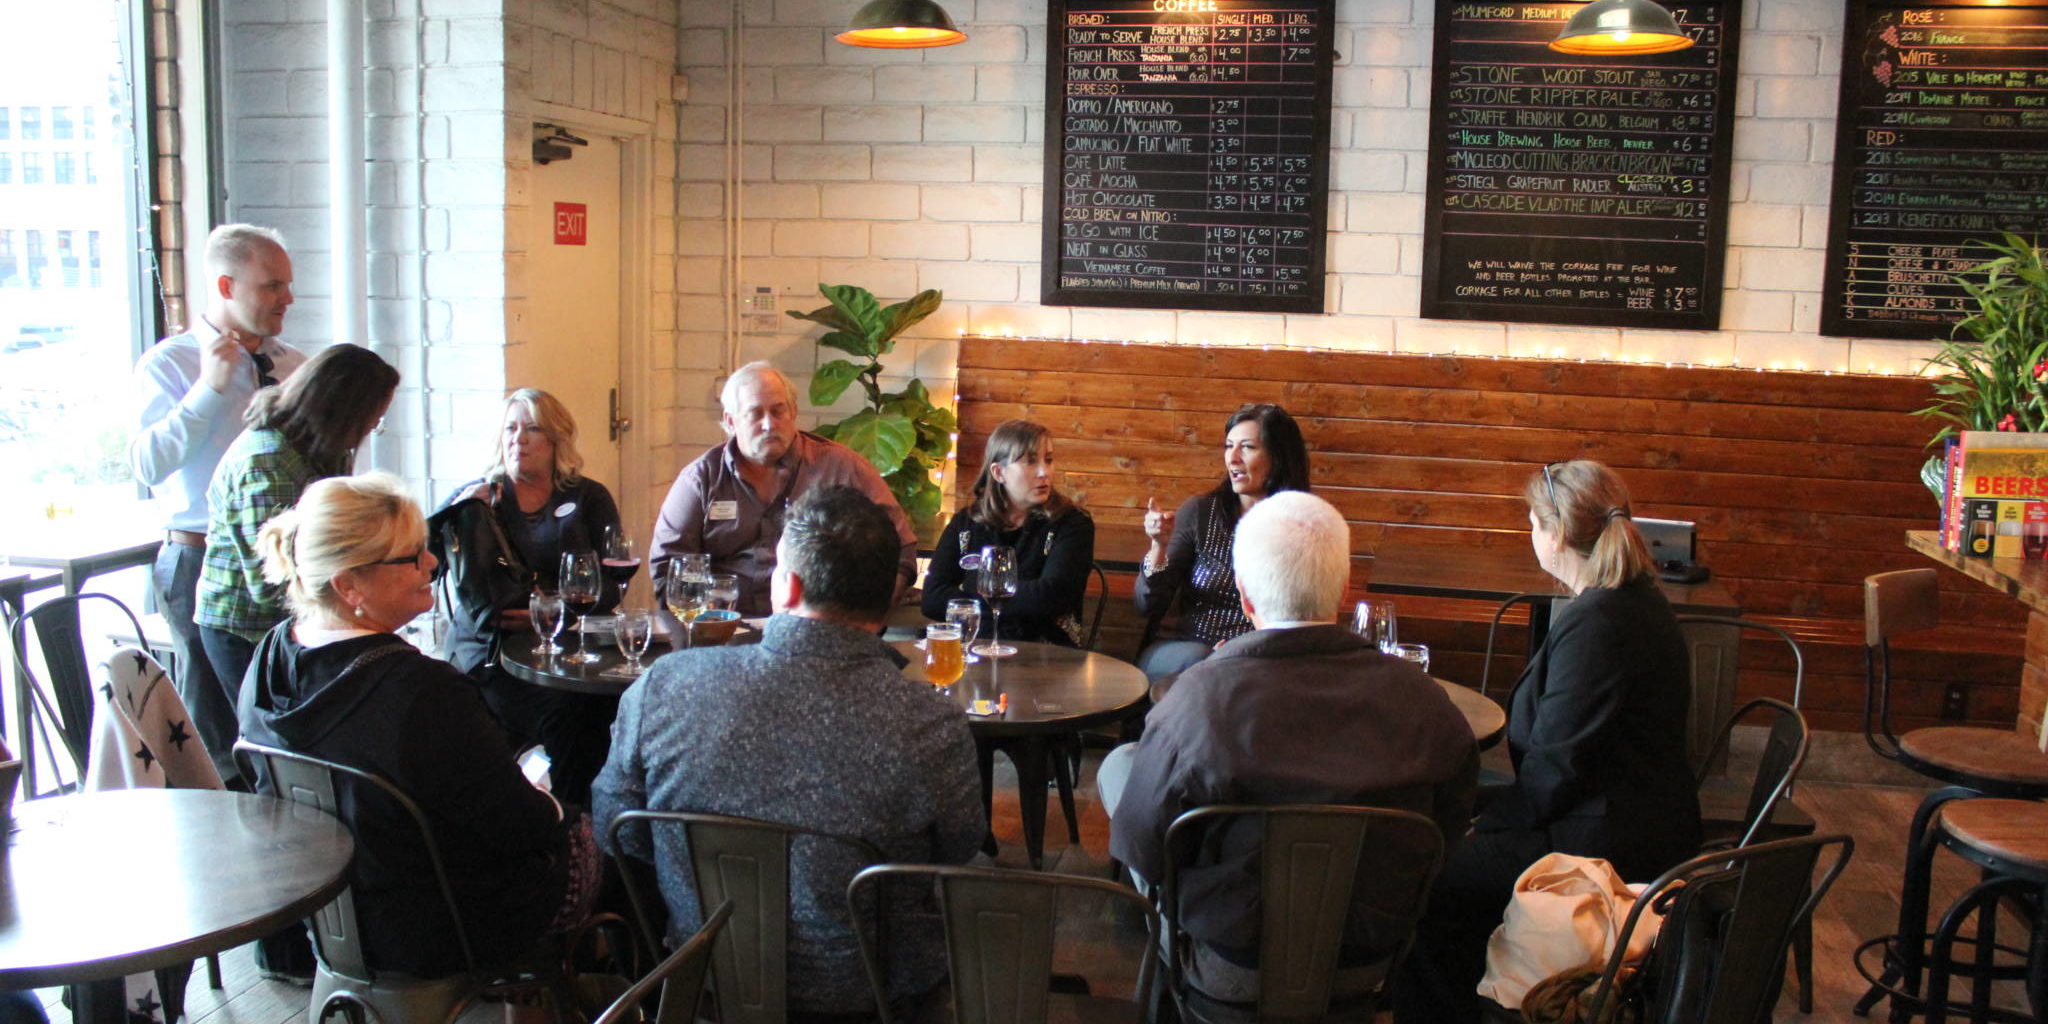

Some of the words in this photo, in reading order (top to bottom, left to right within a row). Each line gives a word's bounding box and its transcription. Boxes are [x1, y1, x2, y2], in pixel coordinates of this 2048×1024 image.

[1153, 0, 1217, 11] COFFEE
[1462, 5, 1514, 20] MUMFORD
[1522, 7, 1557, 19] MEDIUM
[1217, 14, 1245, 24] SINGLE
[1068, 28, 1097, 44] READY
[1112, 30, 1143, 43] SERVE
[1151, 26, 1182, 35] FRENCH
[1185, 26, 1209, 35] PRESS
[1150, 35, 1177, 44] HOUSE
[1180, 35, 1205, 44] BLEND
[1068, 47, 1102, 62] FRENCH
[1107, 47, 1135, 62] PRESS
[1141, 45, 1165, 53] HOUSE
[1068, 66, 1090, 80] POUR
[1093, 66, 1119, 80] OVER
[1139, 64, 1164, 72] HOUSE
[1460, 66, 1524, 84] STONE
[1542, 68, 1586, 84] WOOT
[1139, 74, 1177, 82] TANZANIA
[1463, 87, 1522, 104] STONE
[1067, 98, 1101, 114] DOPPIO
[1114, 98, 1174, 114] AMERICANO
[1065, 117, 1109, 132] CORTADO
[1124, 117, 1182, 133] MACCHIATTO
[1459, 109, 1507, 125] STRAFFE
[1516, 109, 1566, 127] HENDRIK
[1618, 114, 1660, 129] BELGIUM
[1138, 136, 1161, 151] FLAT
[1165, 137, 1192, 152] WHITE
[1461, 130, 1492, 145] HOUSE
[1099, 154, 1126, 170] LATTE
[1455, 151, 1511, 169] MACLEOD
[1512, 152, 1568, 171] CUTTING
[1099, 173, 1138, 188] MOCHA
[1456, 175, 1499, 190] STIEGL
[1507, 175, 1567, 191] GRAPEFRUIT
[1065, 190, 1088, 205] HOT
[1092, 191, 1156, 207] CHOCOLATE
[1461, 193, 1526, 210] CASCADE
[1063, 207, 1089, 220] COLD
[1094, 208, 1120, 220] BREW
[557, 211, 585, 236] EXIT
[1109, 226, 1132, 237] WITH
[1139, 225, 1160, 240] ICE
[1066, 242, 1091, 257] NEAT
[1113, 243, 1148, 258] GLASS
[1887, 247, 1922, 257] CHEESE
[1932, 247, 1959, 258] PLATE
[1083, 261, 1131, 273] VIETNAMESE
[1135, 263, 1168, 276] COFFEE
[1468, 260, 1482, 269] WE
[1486, 261, 1505, 269] WILL
[1508, 261, 1535, 269] WAIVE
[1540, 262, 1555, 270] THE
[1631, 265, 1650, 273] FOR
[1887, 258, 1923, 269] CHEESE
[1475, 272, 1491, 281] AND
[1495, 272, 1516, 281] BEER
[1520, 272, 1550, 282] BOTTLES
[1558, 273, 1599, 282] PROMOTED
[1887, 271, 1950, 284] BRUSCHETTA
[1455, 286, 1498, 296] CORKAGE
[1503, 288, 1521, 296] FOR
[1524, 288, 1541, 298] ALL
[1545, 289, 1573, 298] OTHER
[1579, 289, 1610, 299] BOTTLES
[1629, 288, 1656, 298] WINE
[1887, 284, 1924, 295] OLIVES
[1627, 298, 1653, 309] BEER
[1885, 297, 1936, 309] ALMONDS
[1974, 475, 2048, 497] BEERS
